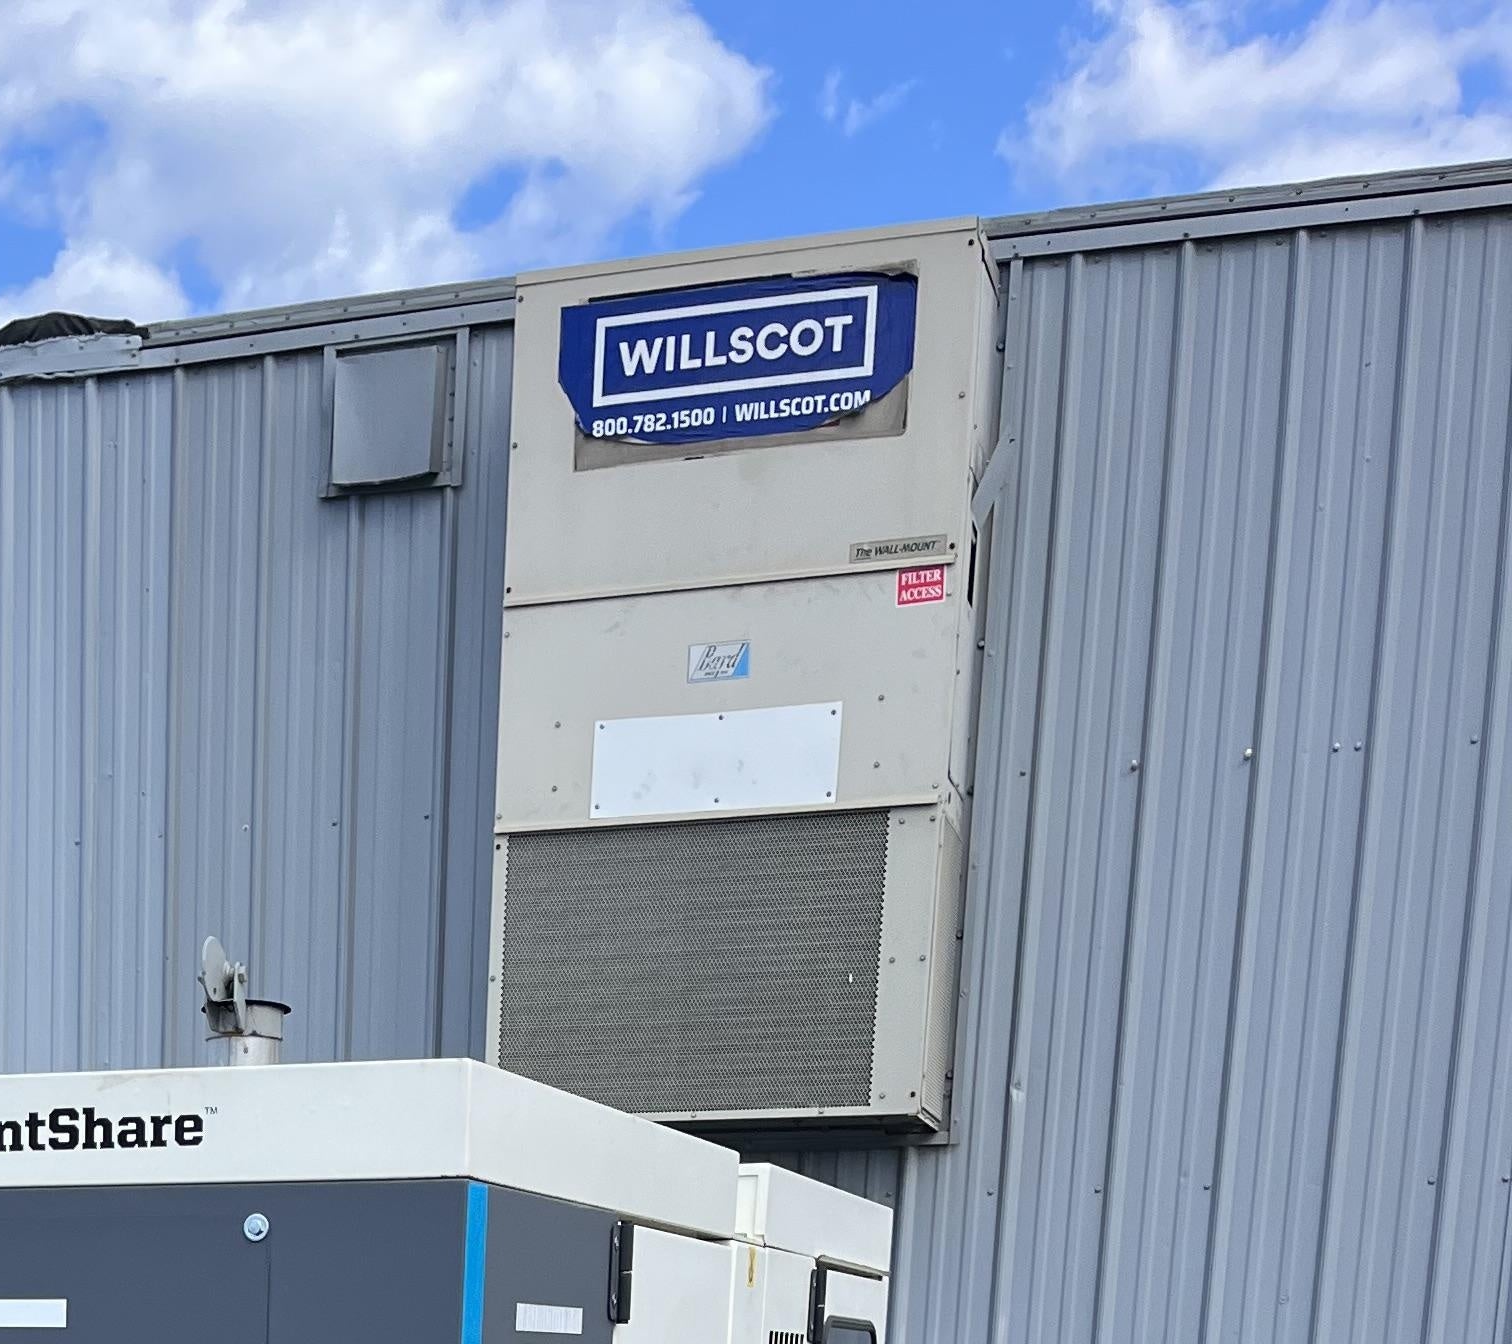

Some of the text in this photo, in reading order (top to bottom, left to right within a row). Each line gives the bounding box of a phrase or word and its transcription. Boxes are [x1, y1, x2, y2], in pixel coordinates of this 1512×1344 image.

[619, 315, 854, 376] WILLSCOT
[592, 389, 872, 438] 800.782.1500 WILLSCOT.COM
[874, 540, 937, 556] WALL-MOUNT
[901, 569, 941, 586] FILTER
[899, 585, 942, 602] ACCESS
